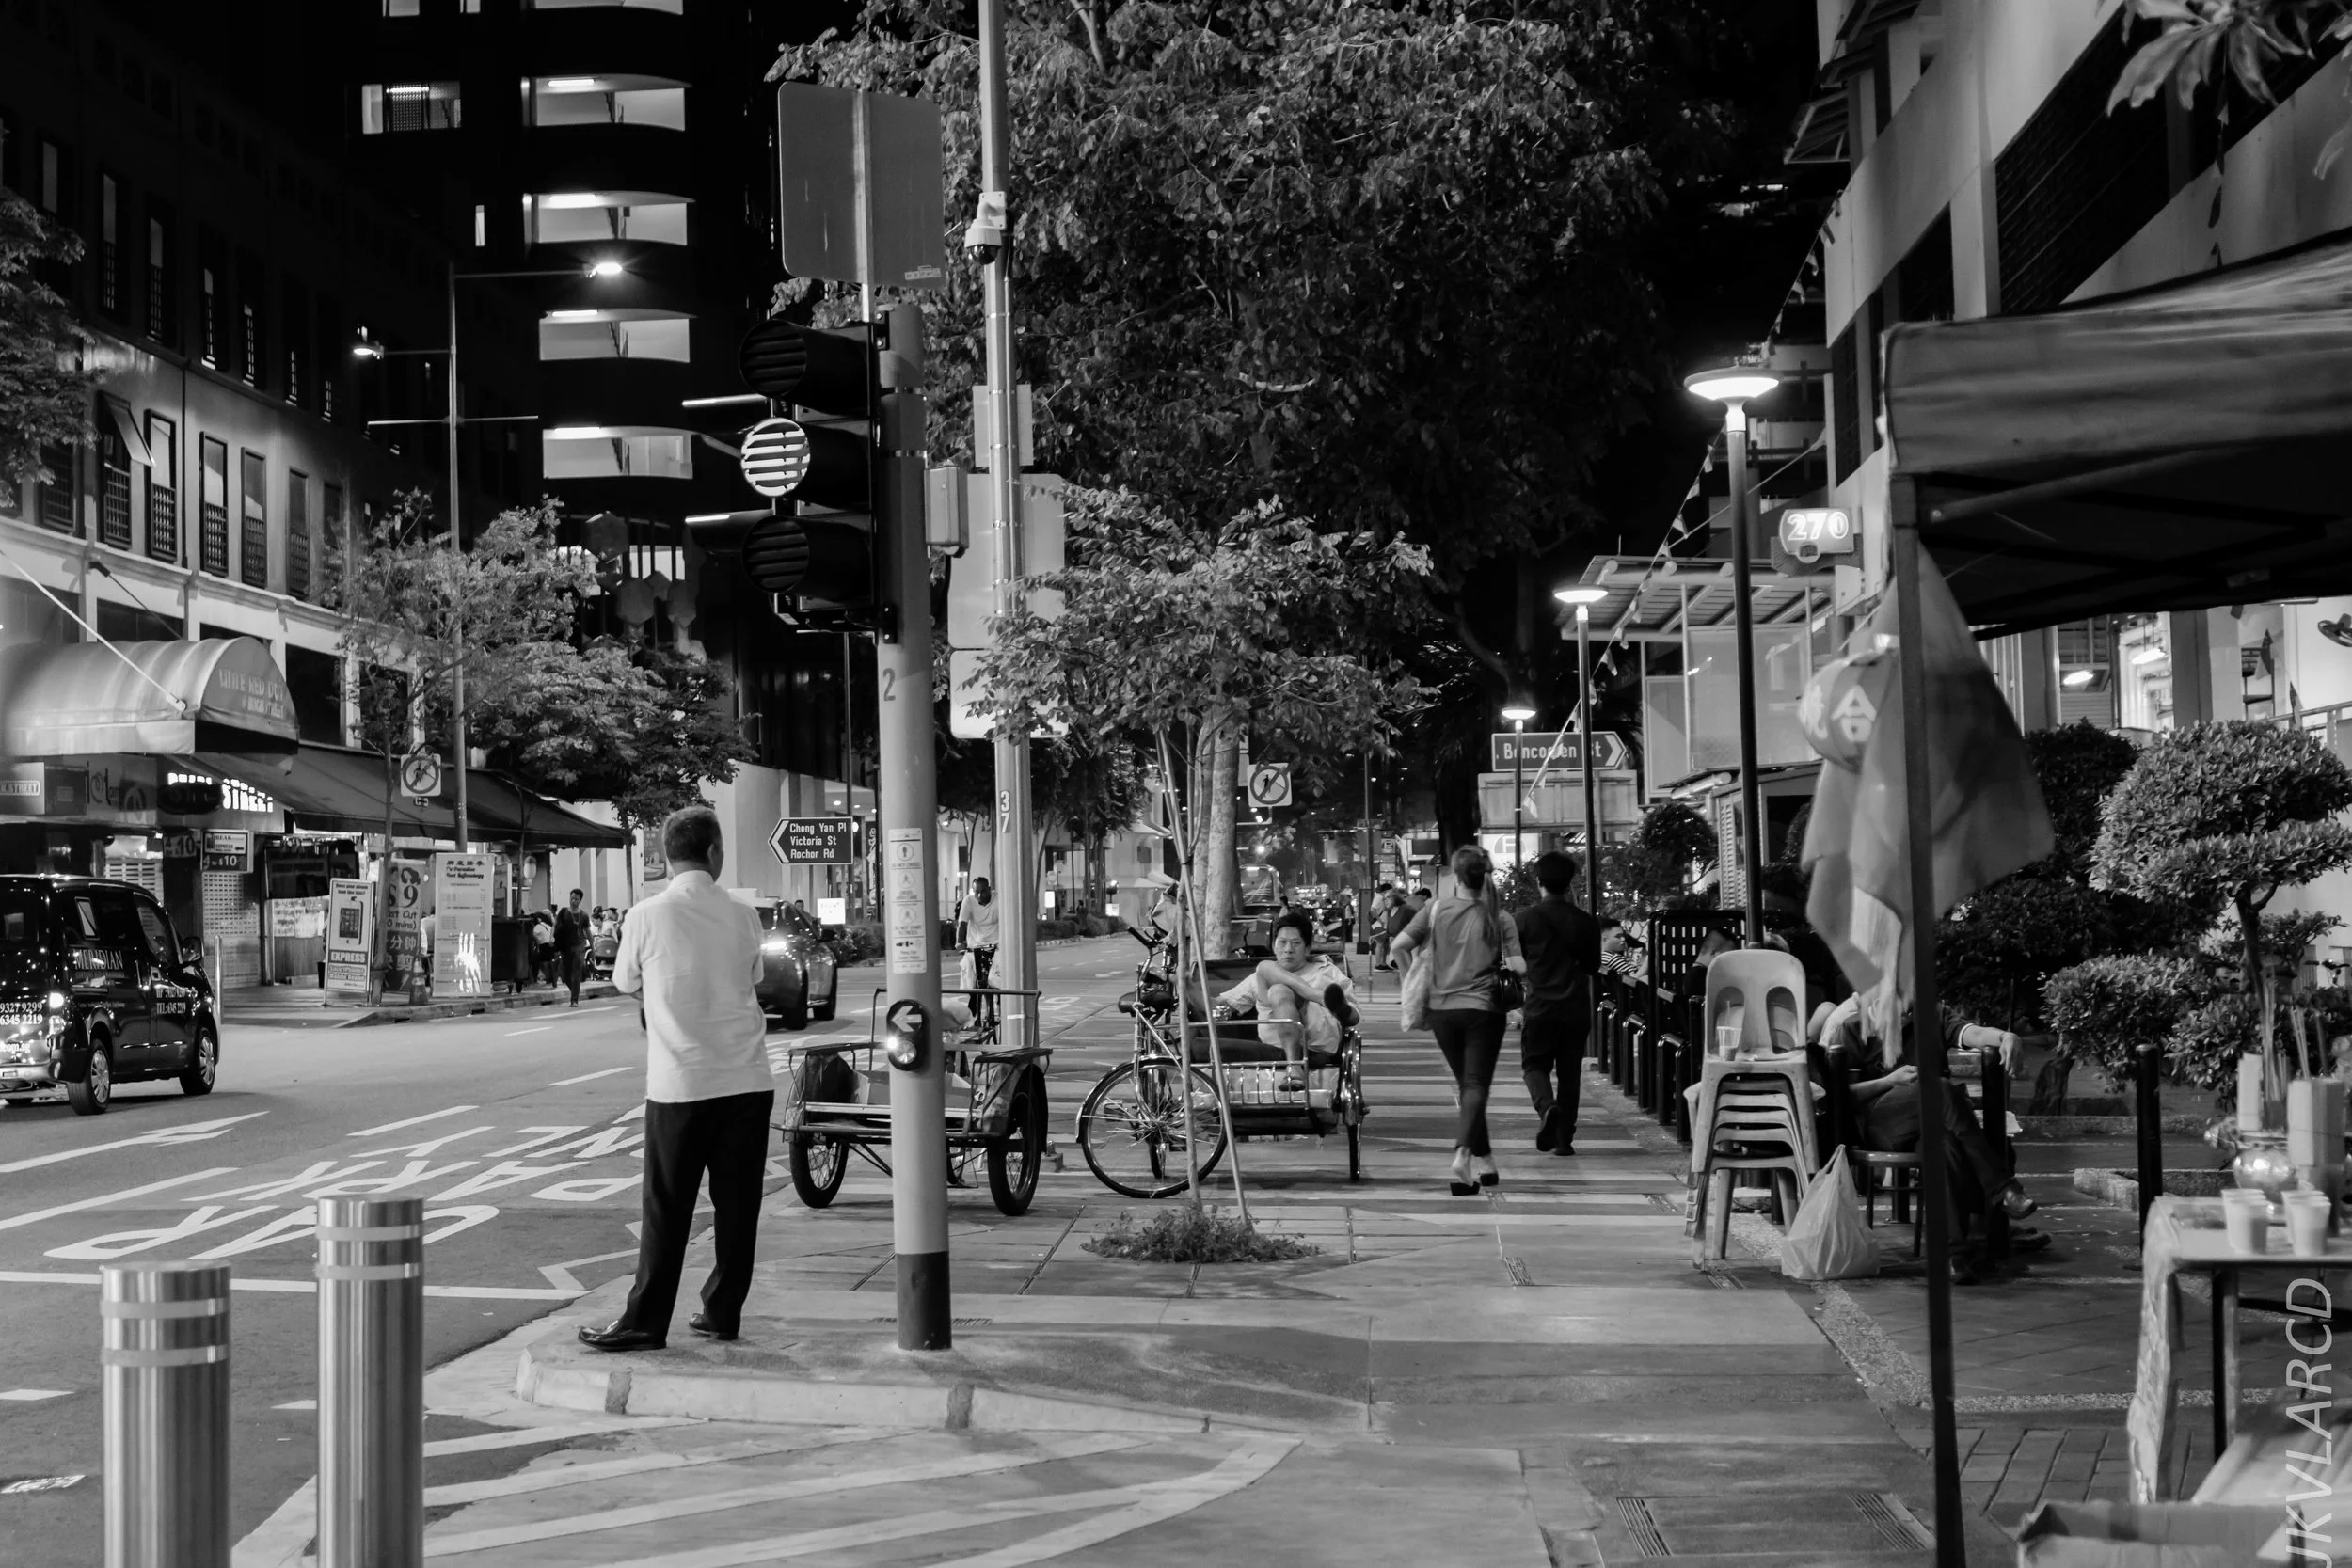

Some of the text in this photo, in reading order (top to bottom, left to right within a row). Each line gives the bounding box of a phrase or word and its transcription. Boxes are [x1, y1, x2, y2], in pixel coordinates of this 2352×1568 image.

[1788, 511, 1849, 541] 270
[883, 667, 896, 702] 2
[790, 823, 815, 835] Cheng
[818, 822, 834, 832] Yan
[790, 835, 837, 846] Victoria St
[790, 848, 834, 859] Rochor Rd
[73, 949, 124, 970] MERIDIAN
[330, 951, 366, 963] EXPRESS
[21, 1002, 43, 1013] 9299
[22, 1014, 43, 1025] 2219
[349, 1125, 645, 1158] NLY
